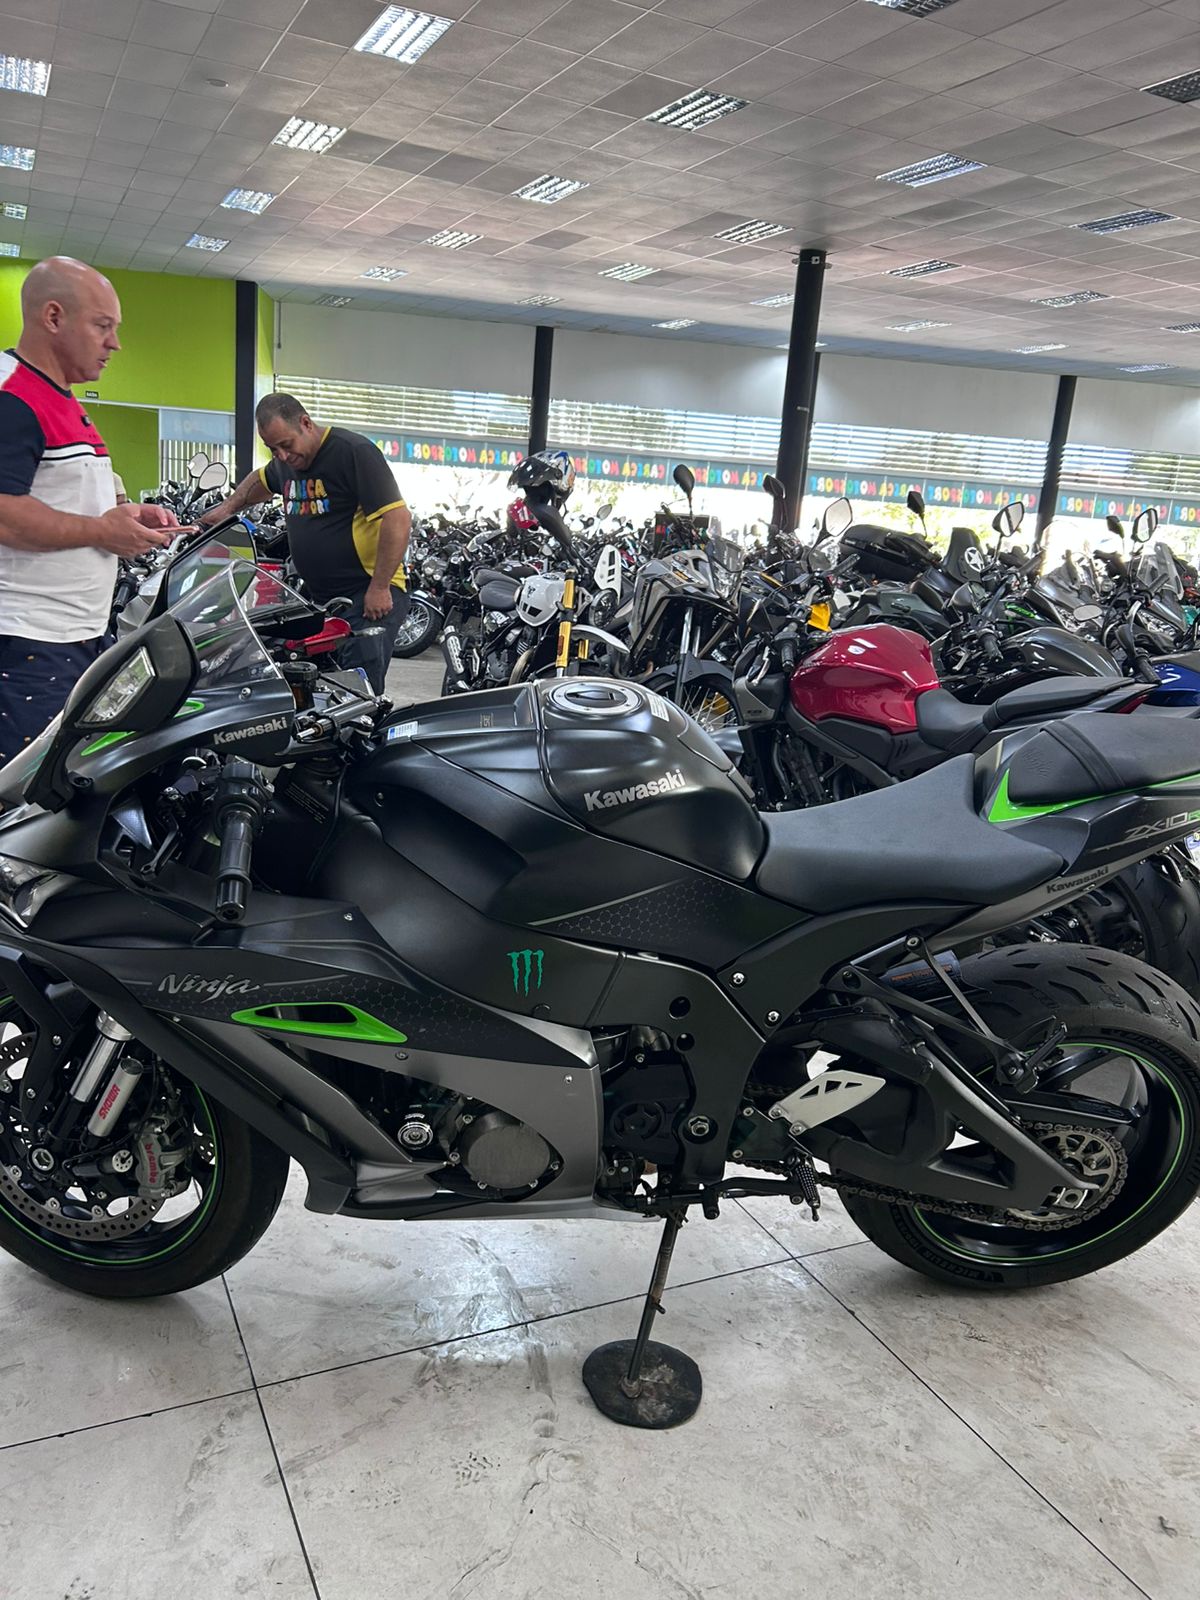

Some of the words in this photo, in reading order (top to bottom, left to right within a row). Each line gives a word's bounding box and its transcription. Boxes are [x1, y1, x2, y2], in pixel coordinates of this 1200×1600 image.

[213, 716, 288, 745] Kawasaki
[583, 769, 686, 812] Kawasaki
[1046, 865, 1109, 893] Kawasaki
[158, 973, 260, 1004] Ninja
[98, 1083, 121, 1120] SHOWA
